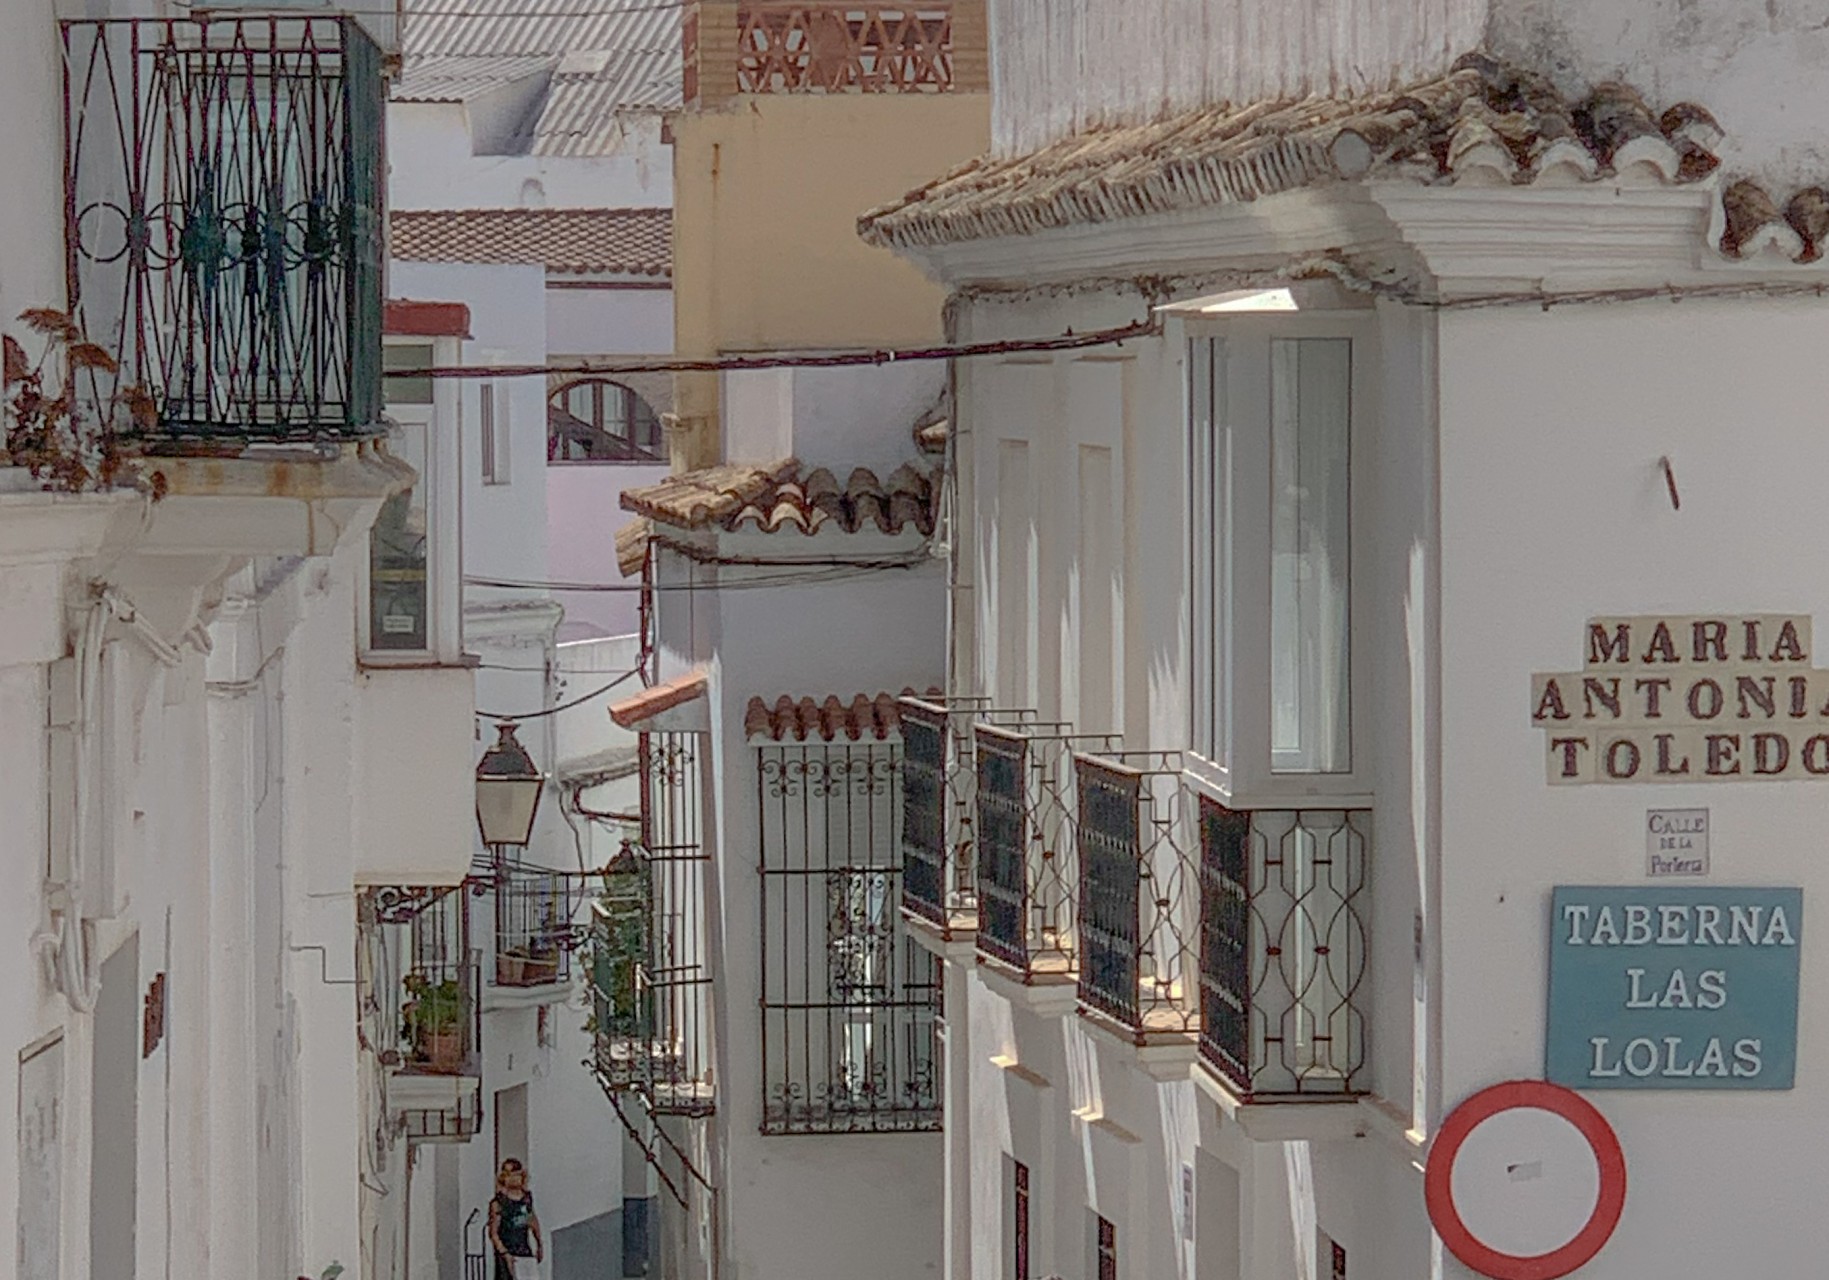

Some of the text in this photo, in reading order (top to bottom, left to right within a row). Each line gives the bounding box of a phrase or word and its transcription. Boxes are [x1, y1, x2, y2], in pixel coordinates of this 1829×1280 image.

[1589, 620, 1807, 663] MARIA
[1533, 676, 1829, 720] ANTONI
[1552, 733, 1829, 778] TOLEDO
[1563, 906, 1795, 946] TABERNA
[1626, 969, 1727, 1009] LAS
[1589, 1038, 1763, 1077] LOLAS
